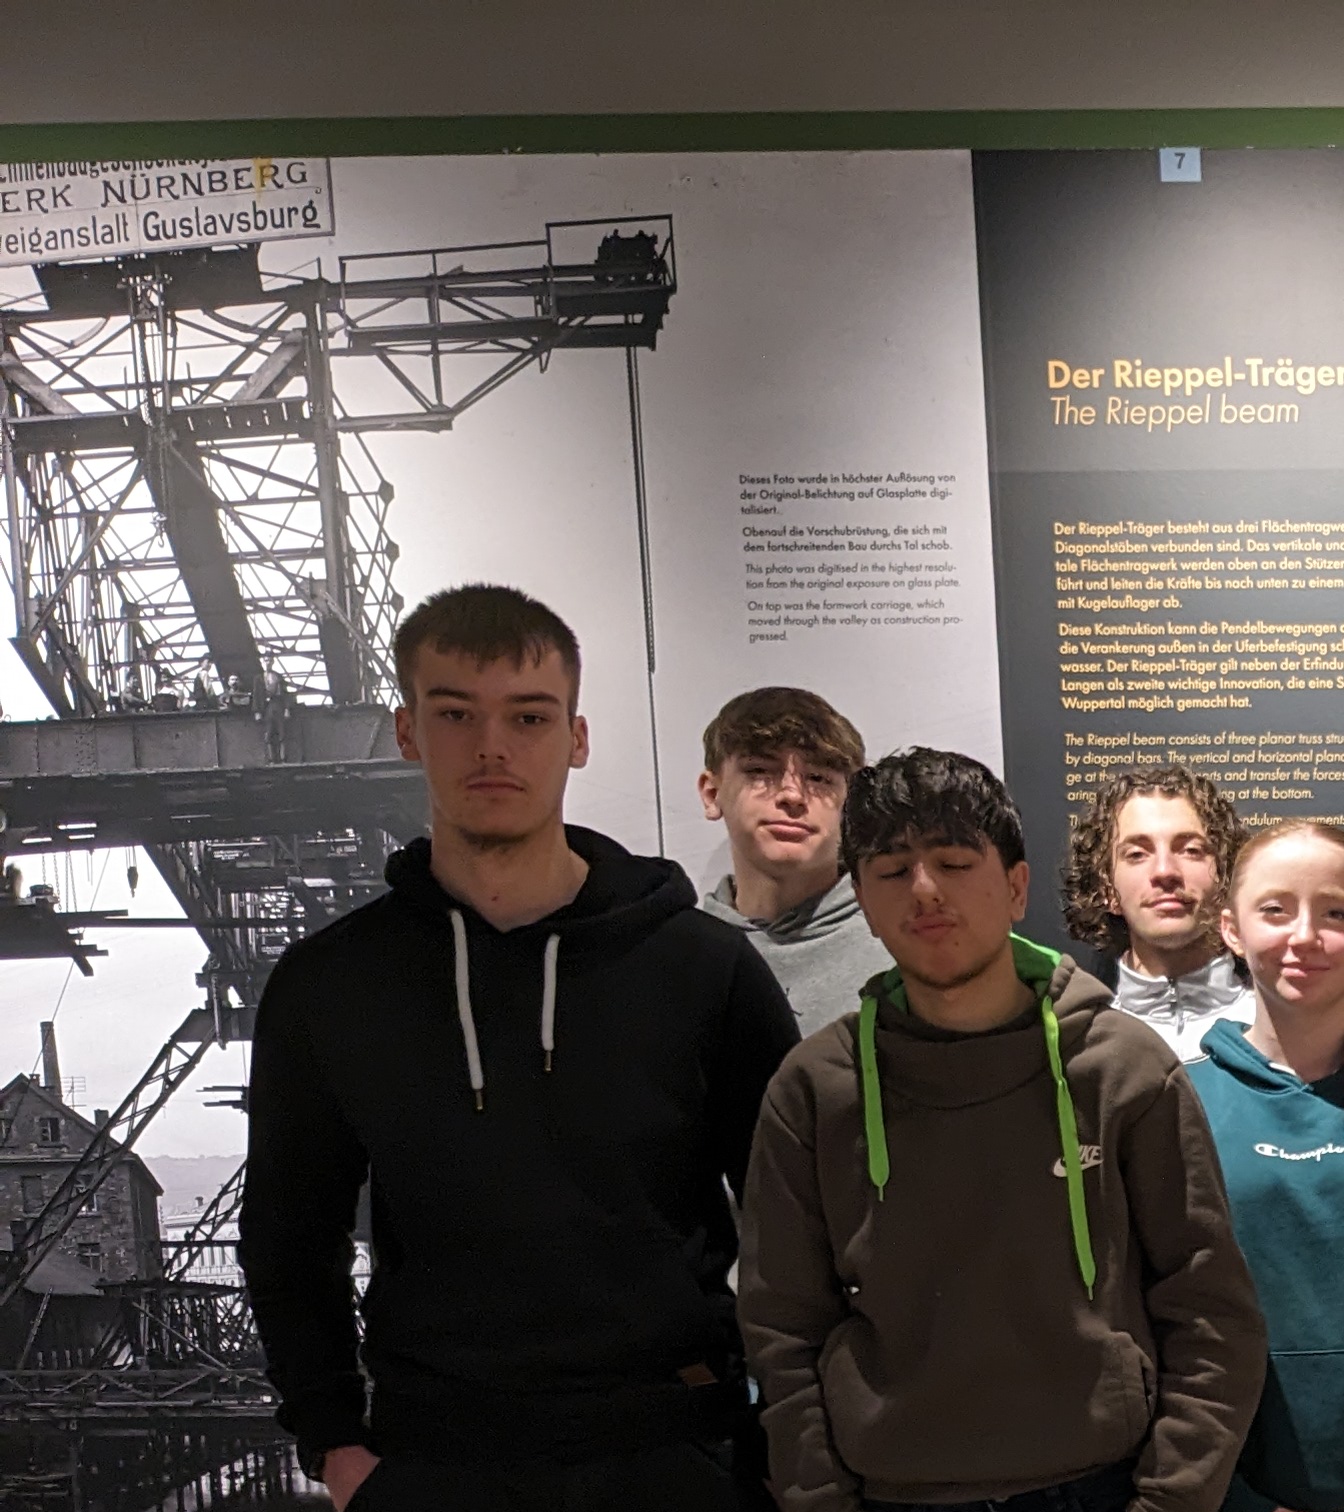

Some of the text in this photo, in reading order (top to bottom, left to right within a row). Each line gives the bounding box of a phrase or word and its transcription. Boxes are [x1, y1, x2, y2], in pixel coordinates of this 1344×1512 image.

[1174, 152, 1186, 169] 7
[1047, 359, 1105, 389] Der
[1051, 395, 1300, 432] The Rieppel beam
[1054, 521, 1075, 535] Der
[1078, 520, 1164, 538] Rieppel-Träger
[1166, 520, 1209, 534] besteht
[1211, 524, 1233, 533] aus
[1235, 520, 1258, 533] drei
[1055, 539, 1148, 556] Diagonalstäben
[1150, 538, 1213, 552] verbunden
[1216, 538, 1243, 552] sind.
[1246, 538, 1270, 551] Das
[1272, 537, 1322, 551] vertikale
[1055, 558, 1077, 572] tale
[1080, 557, 1177, 575] Flächentragwerk
[1179, 557, 1224, 571] werden
[1226, 557, 1257, 570] oben
[1260, 561, 1276, 570] an
[1278, 556, 1301, 570] den
